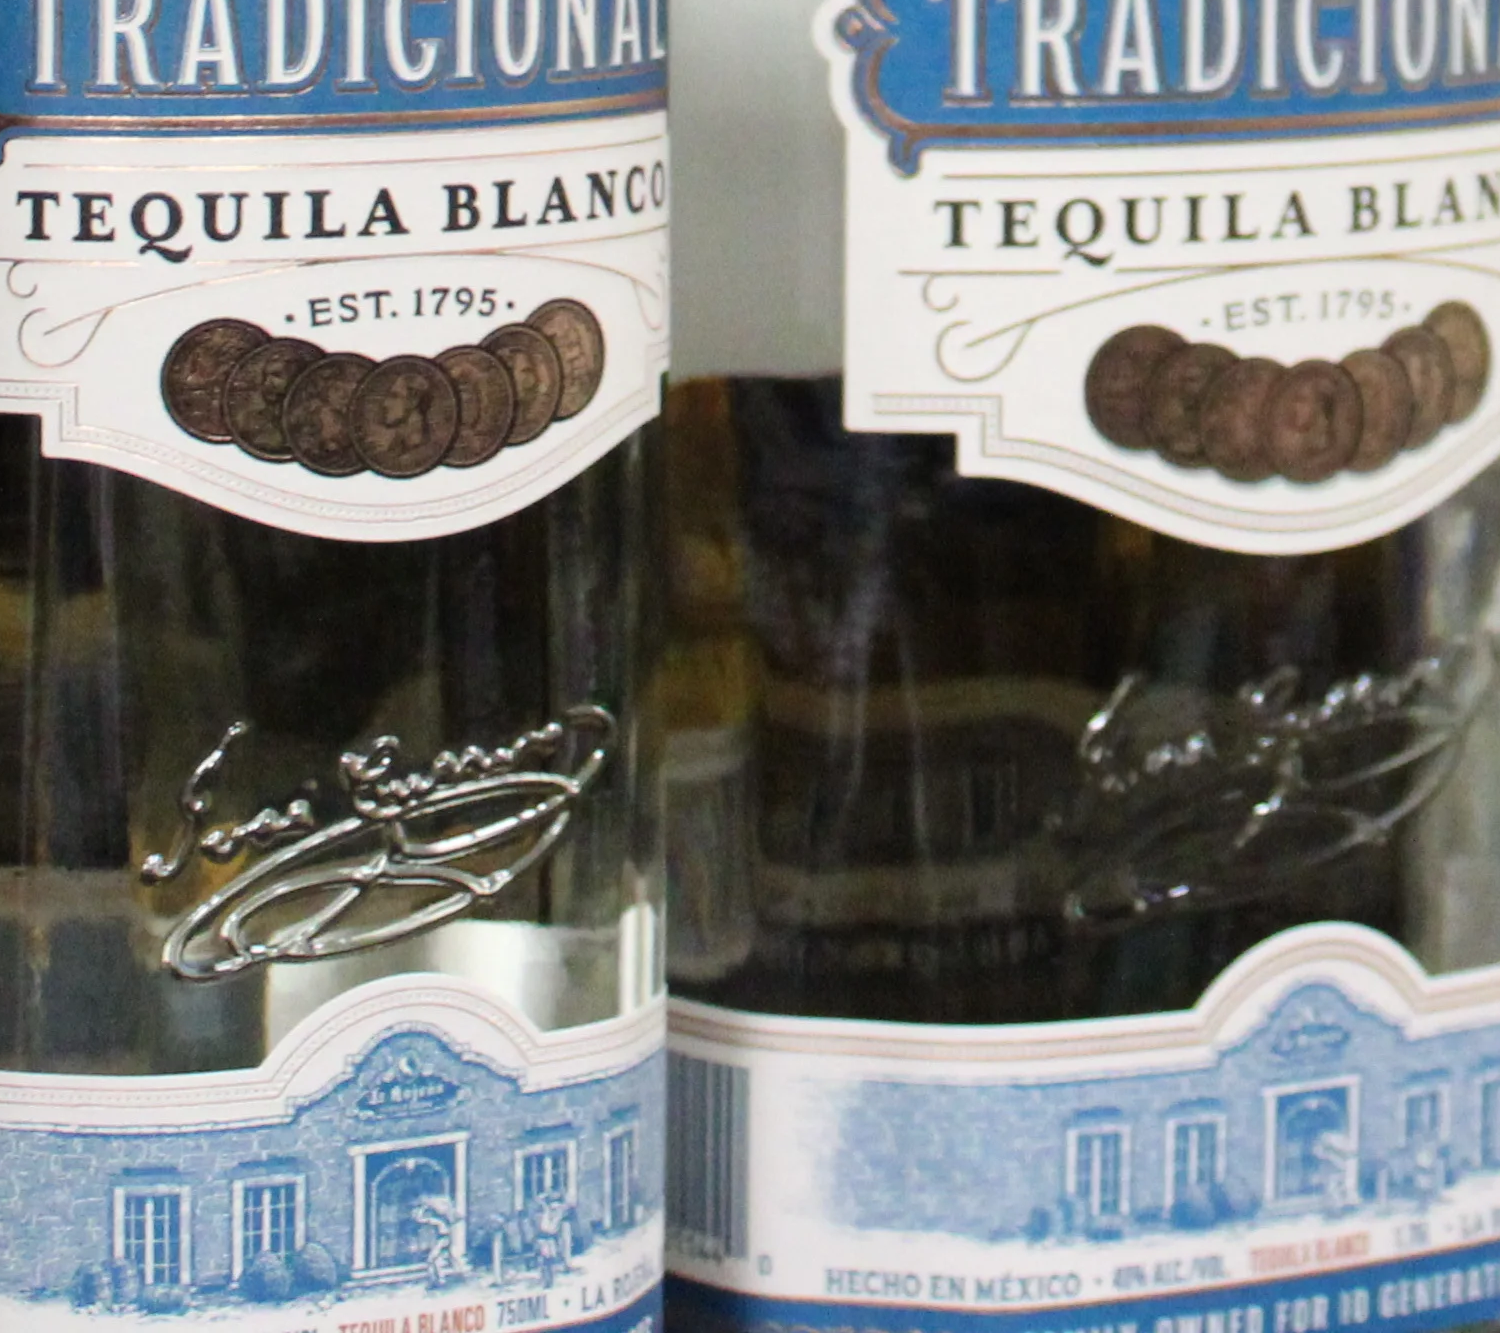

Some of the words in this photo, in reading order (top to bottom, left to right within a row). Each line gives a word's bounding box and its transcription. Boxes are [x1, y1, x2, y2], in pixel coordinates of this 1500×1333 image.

[15, 187, 411, 264] TEQUILA
[440, 159, 667, 233] BLANCO
[933, 191, 1317, 268] TEQUILA
[308, 290, 400, 327] EST.
[411, 286, 499, 320] 1795
[1317, 288, 1398, 322] 1795
[824, 1266, 924, 1299] HECHO
[929, 1271, 966, 1301] EN
[973, 1262, 1082, 1302] MÉXICO
[1273, 1294, 1331, 1333] FOR
